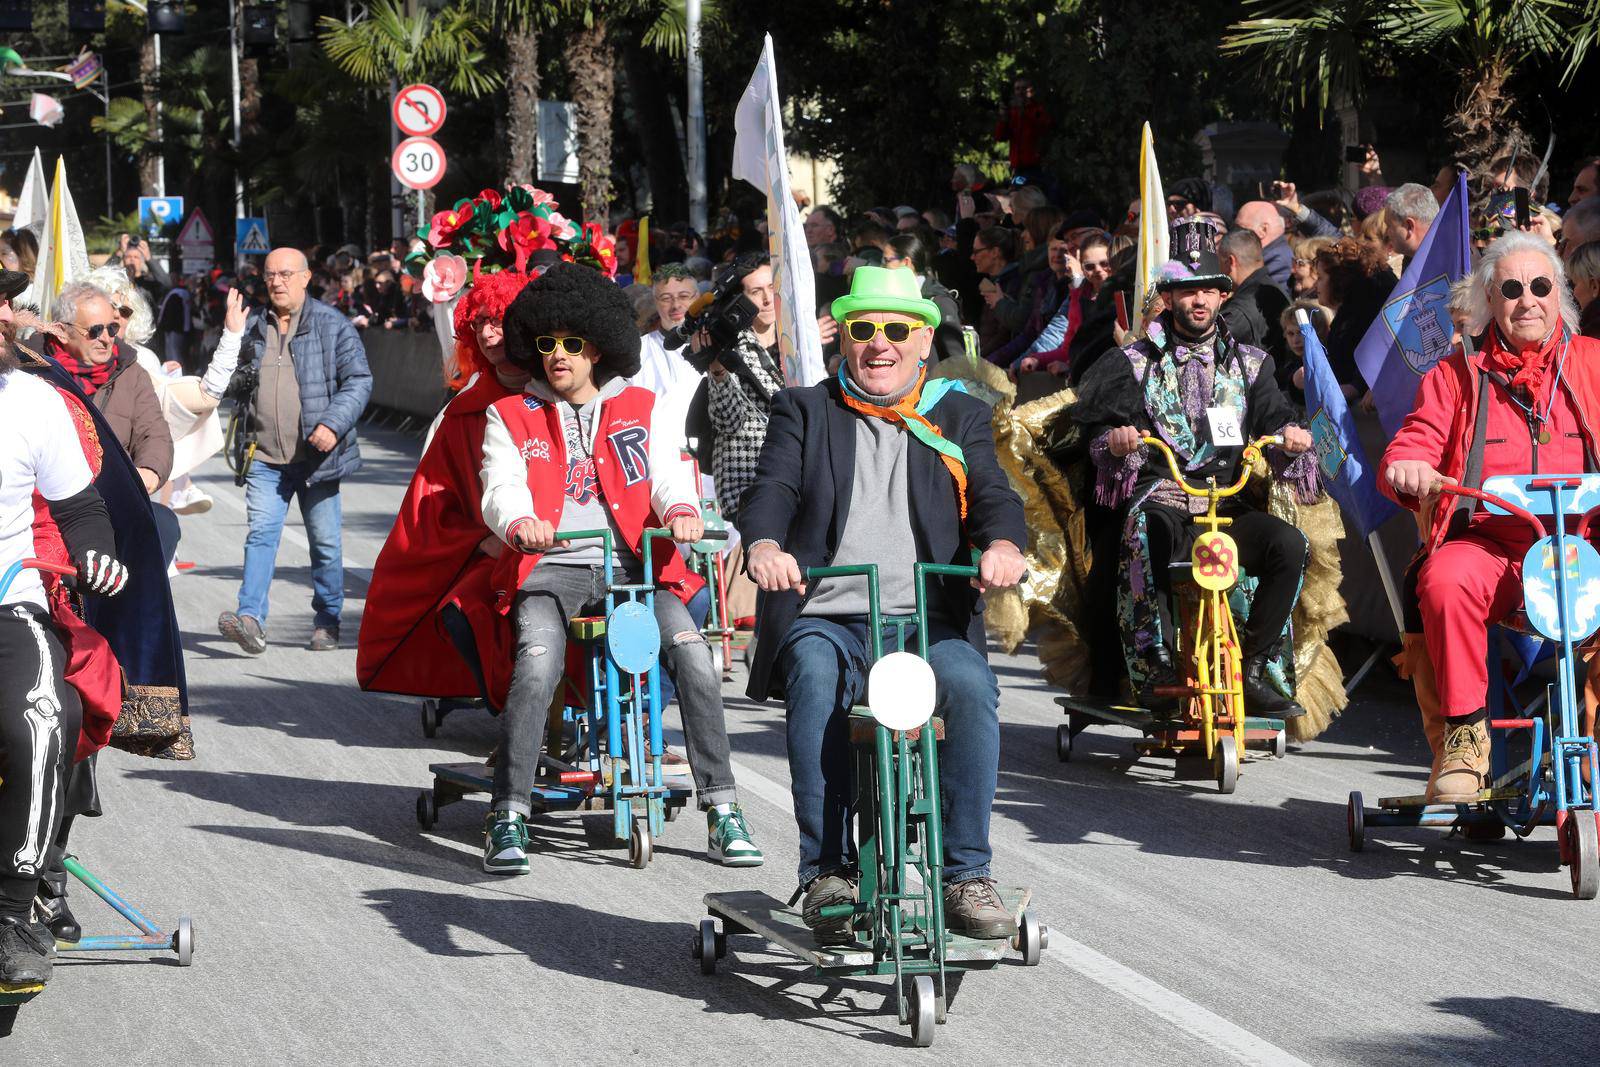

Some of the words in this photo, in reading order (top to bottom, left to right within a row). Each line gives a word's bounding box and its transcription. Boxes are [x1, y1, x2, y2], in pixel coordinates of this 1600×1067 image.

[406, 152, 433, 172] 30
[1217, 422, 1236, 438] ŠČ
[607, 426, 650, 487] R
